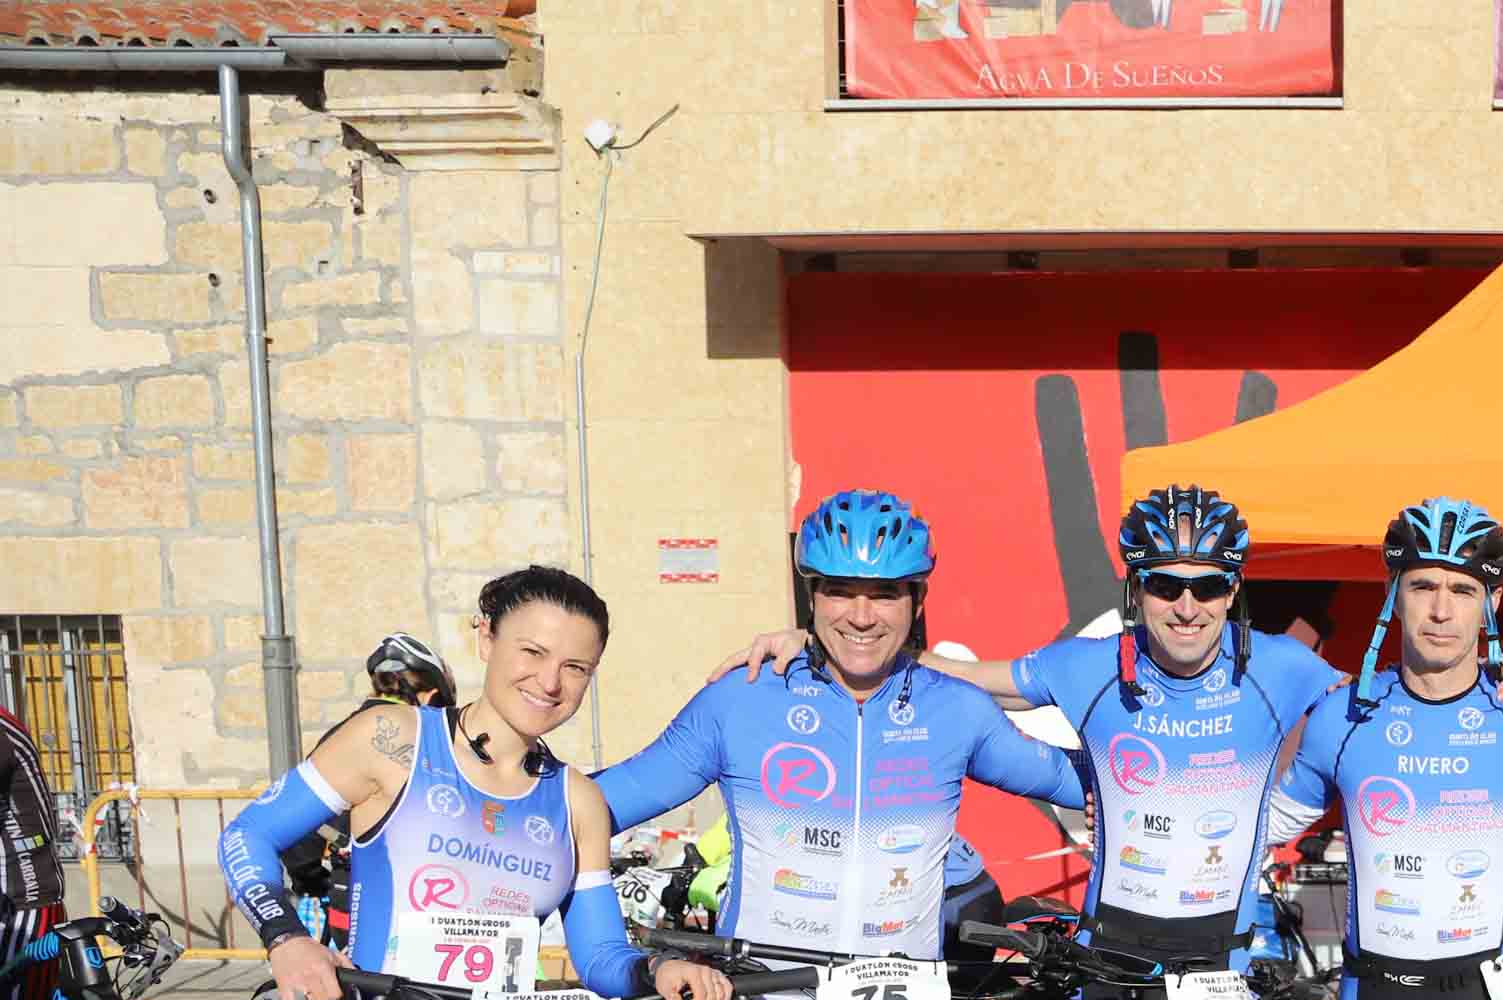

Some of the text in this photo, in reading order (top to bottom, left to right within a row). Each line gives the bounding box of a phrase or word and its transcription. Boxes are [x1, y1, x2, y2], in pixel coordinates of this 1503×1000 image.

[1133, 712, 1233, 738] J.SÁNCHEZ
[1397, 754, 1470, 775] RIVERO
[1143, 813, 1171, 833] MSC
[804, 827, 841, 849] MSC
[428, 832, 553, 882] DOMÍNGUEZ
[1394, 855, 1422, 872] MSC
[244, 882, 285, 921] CLUB
[443, 927, 499, 938] VILLAMAYOR
[433, 944, 494, 983] 79
[856, 970, 910, 981] VILLAMAYOR
